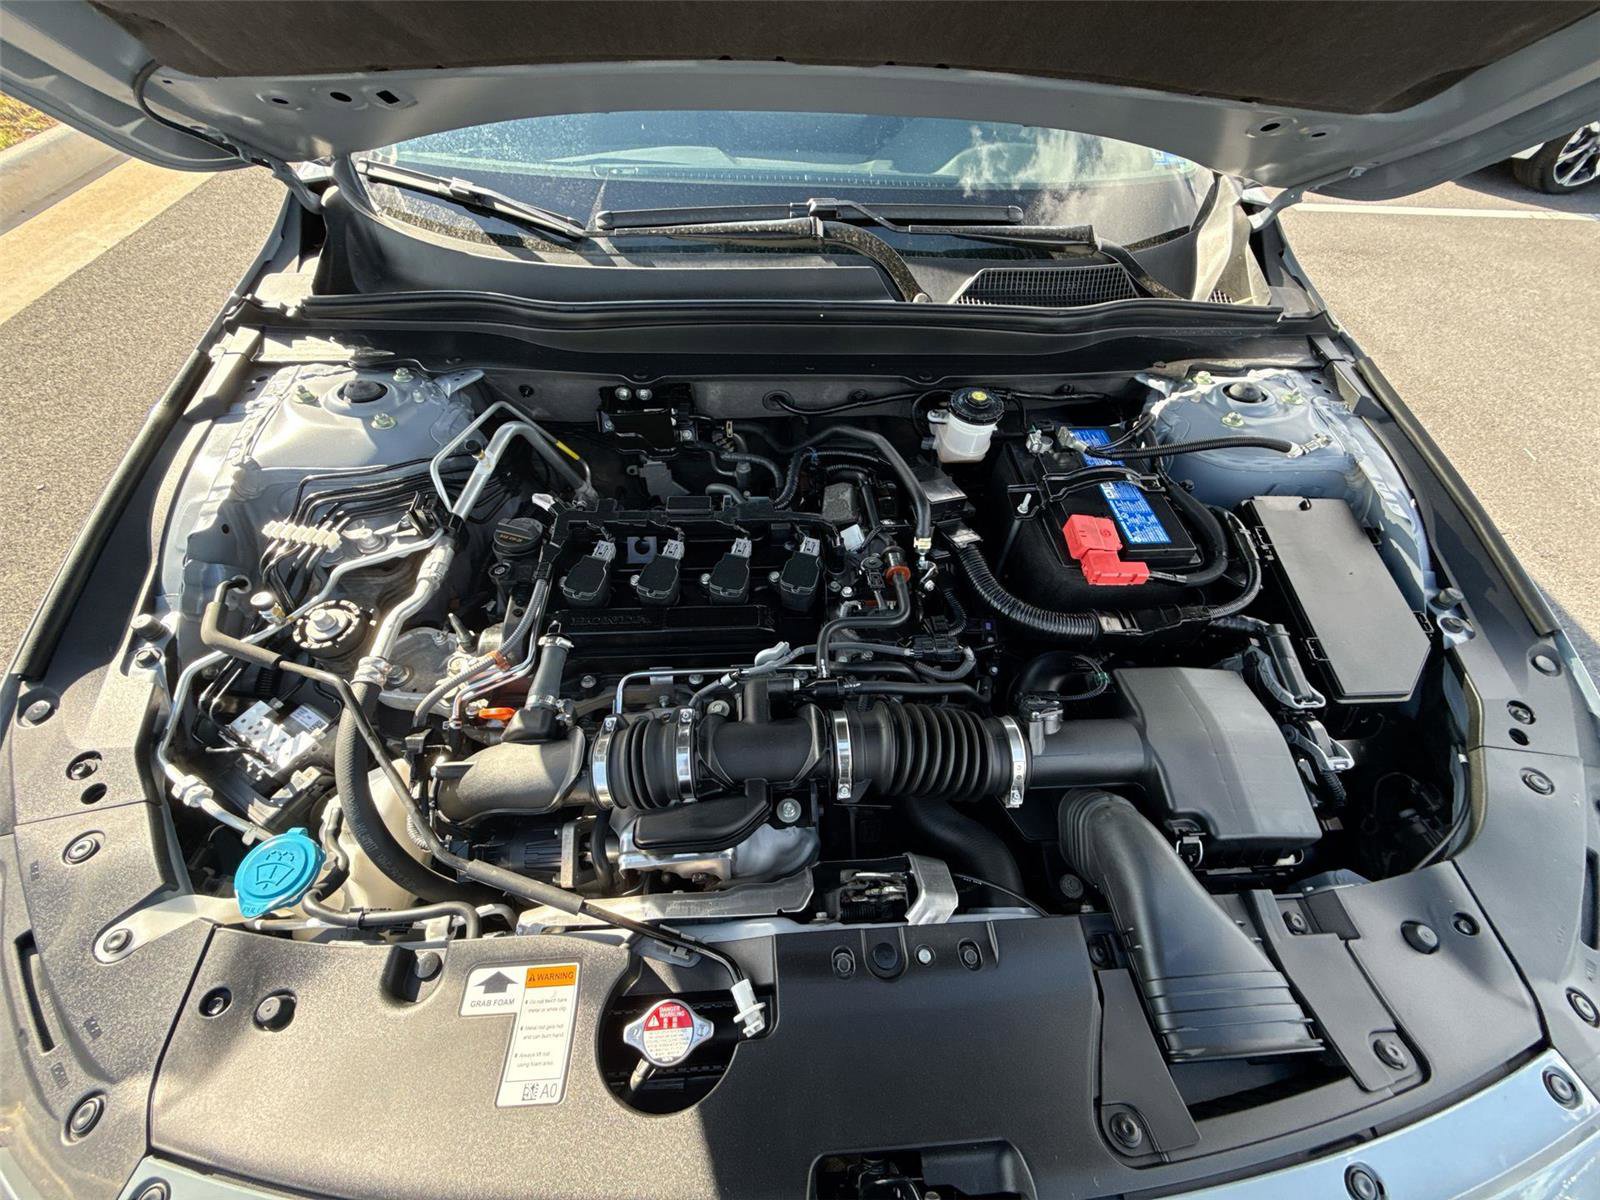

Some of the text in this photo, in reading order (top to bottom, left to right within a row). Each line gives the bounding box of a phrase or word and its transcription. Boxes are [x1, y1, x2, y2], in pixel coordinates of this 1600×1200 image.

[570, 615, 652, 626] HONDA
[537, 971, 574, 981] WARNING
[470, 998, 515, 1008] GRAB FOAM
[540, 1083, 558, 1098] A0
